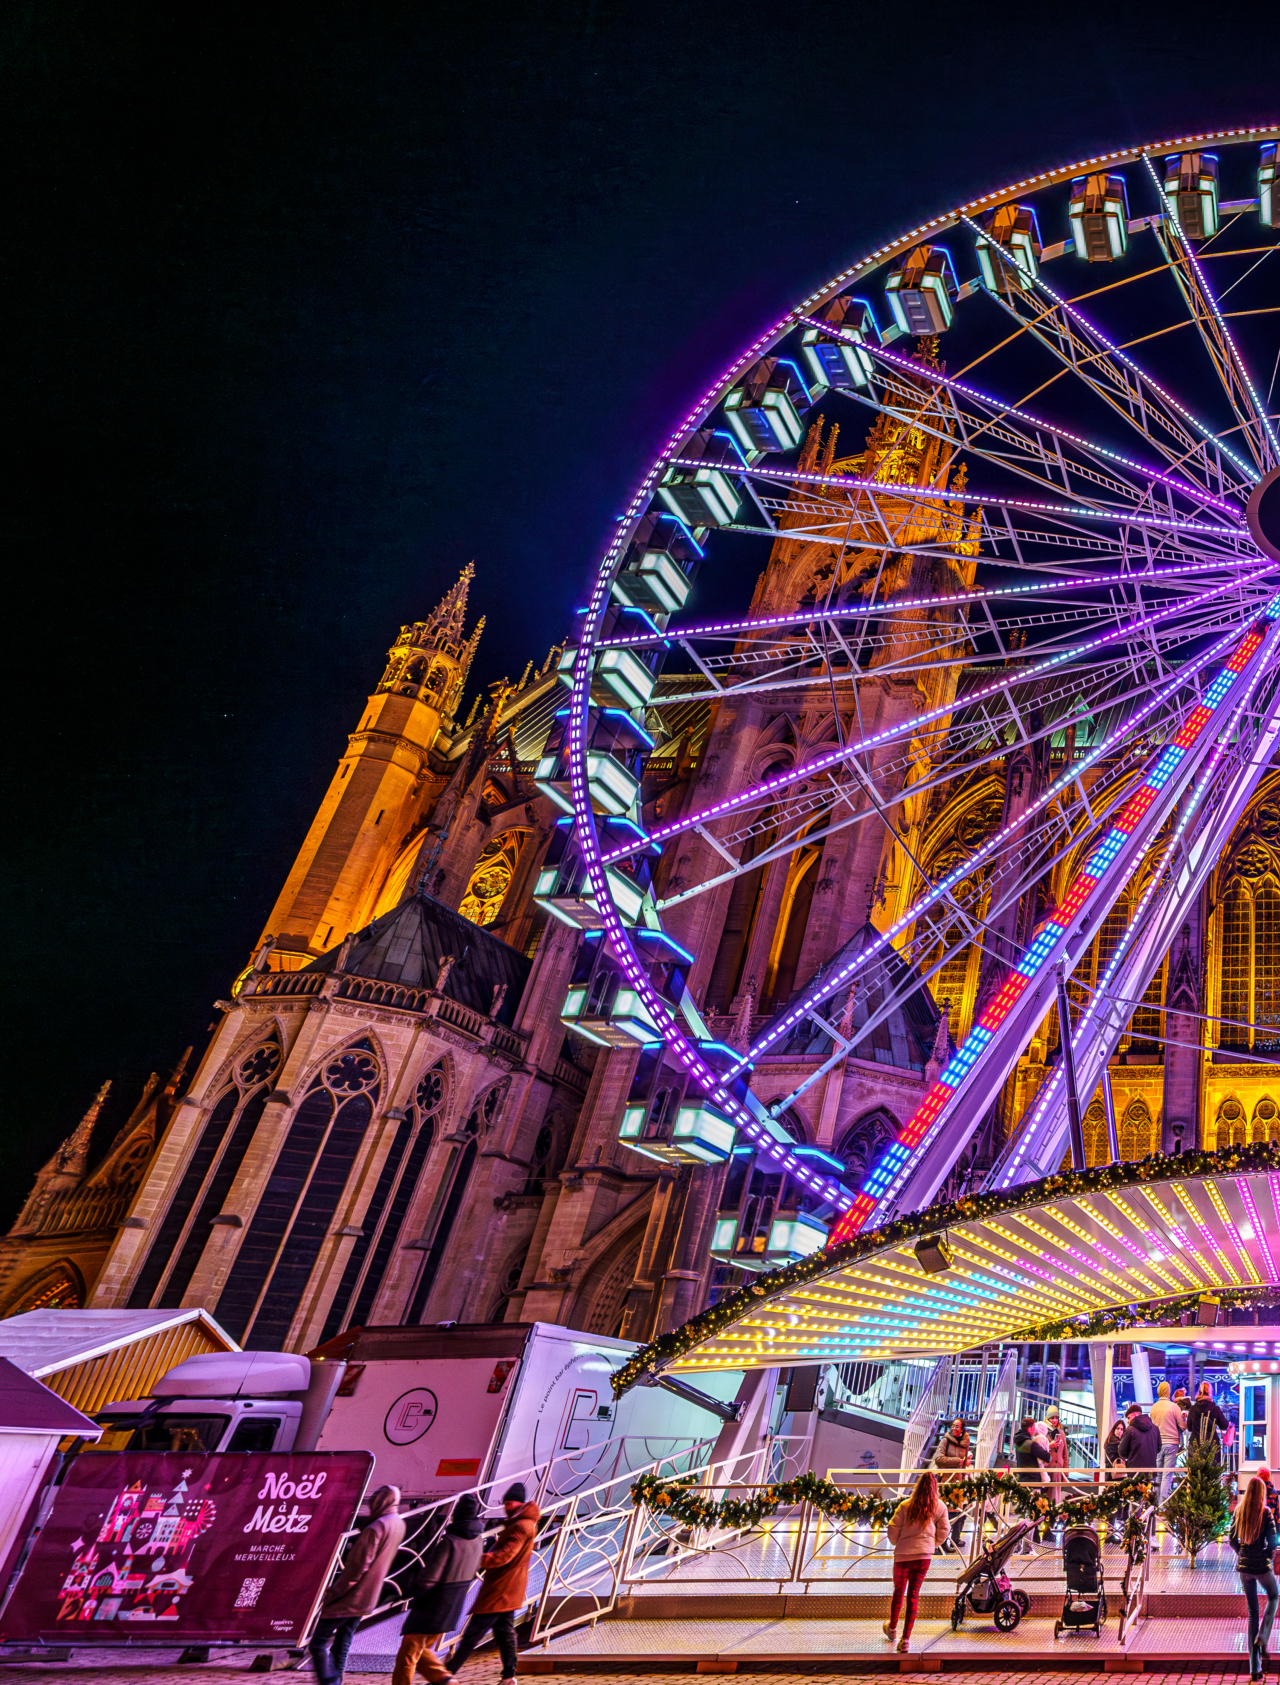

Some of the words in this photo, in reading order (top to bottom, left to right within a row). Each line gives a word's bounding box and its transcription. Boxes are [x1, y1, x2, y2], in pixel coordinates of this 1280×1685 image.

[538, 1403, 545, 1413] Le
[543, 1381, 556, 1403] point
[554, 1369, 564, 1381] bar
[257, 1471, 327, 1500] Noël
[278, 1501, 287, 1513] à
[243, 1505, 313, 1533] Metz
[234, 1553, 296, 1561] MERVEILLEUX
[249, 1544, 286, 1552] MARCHÉ
